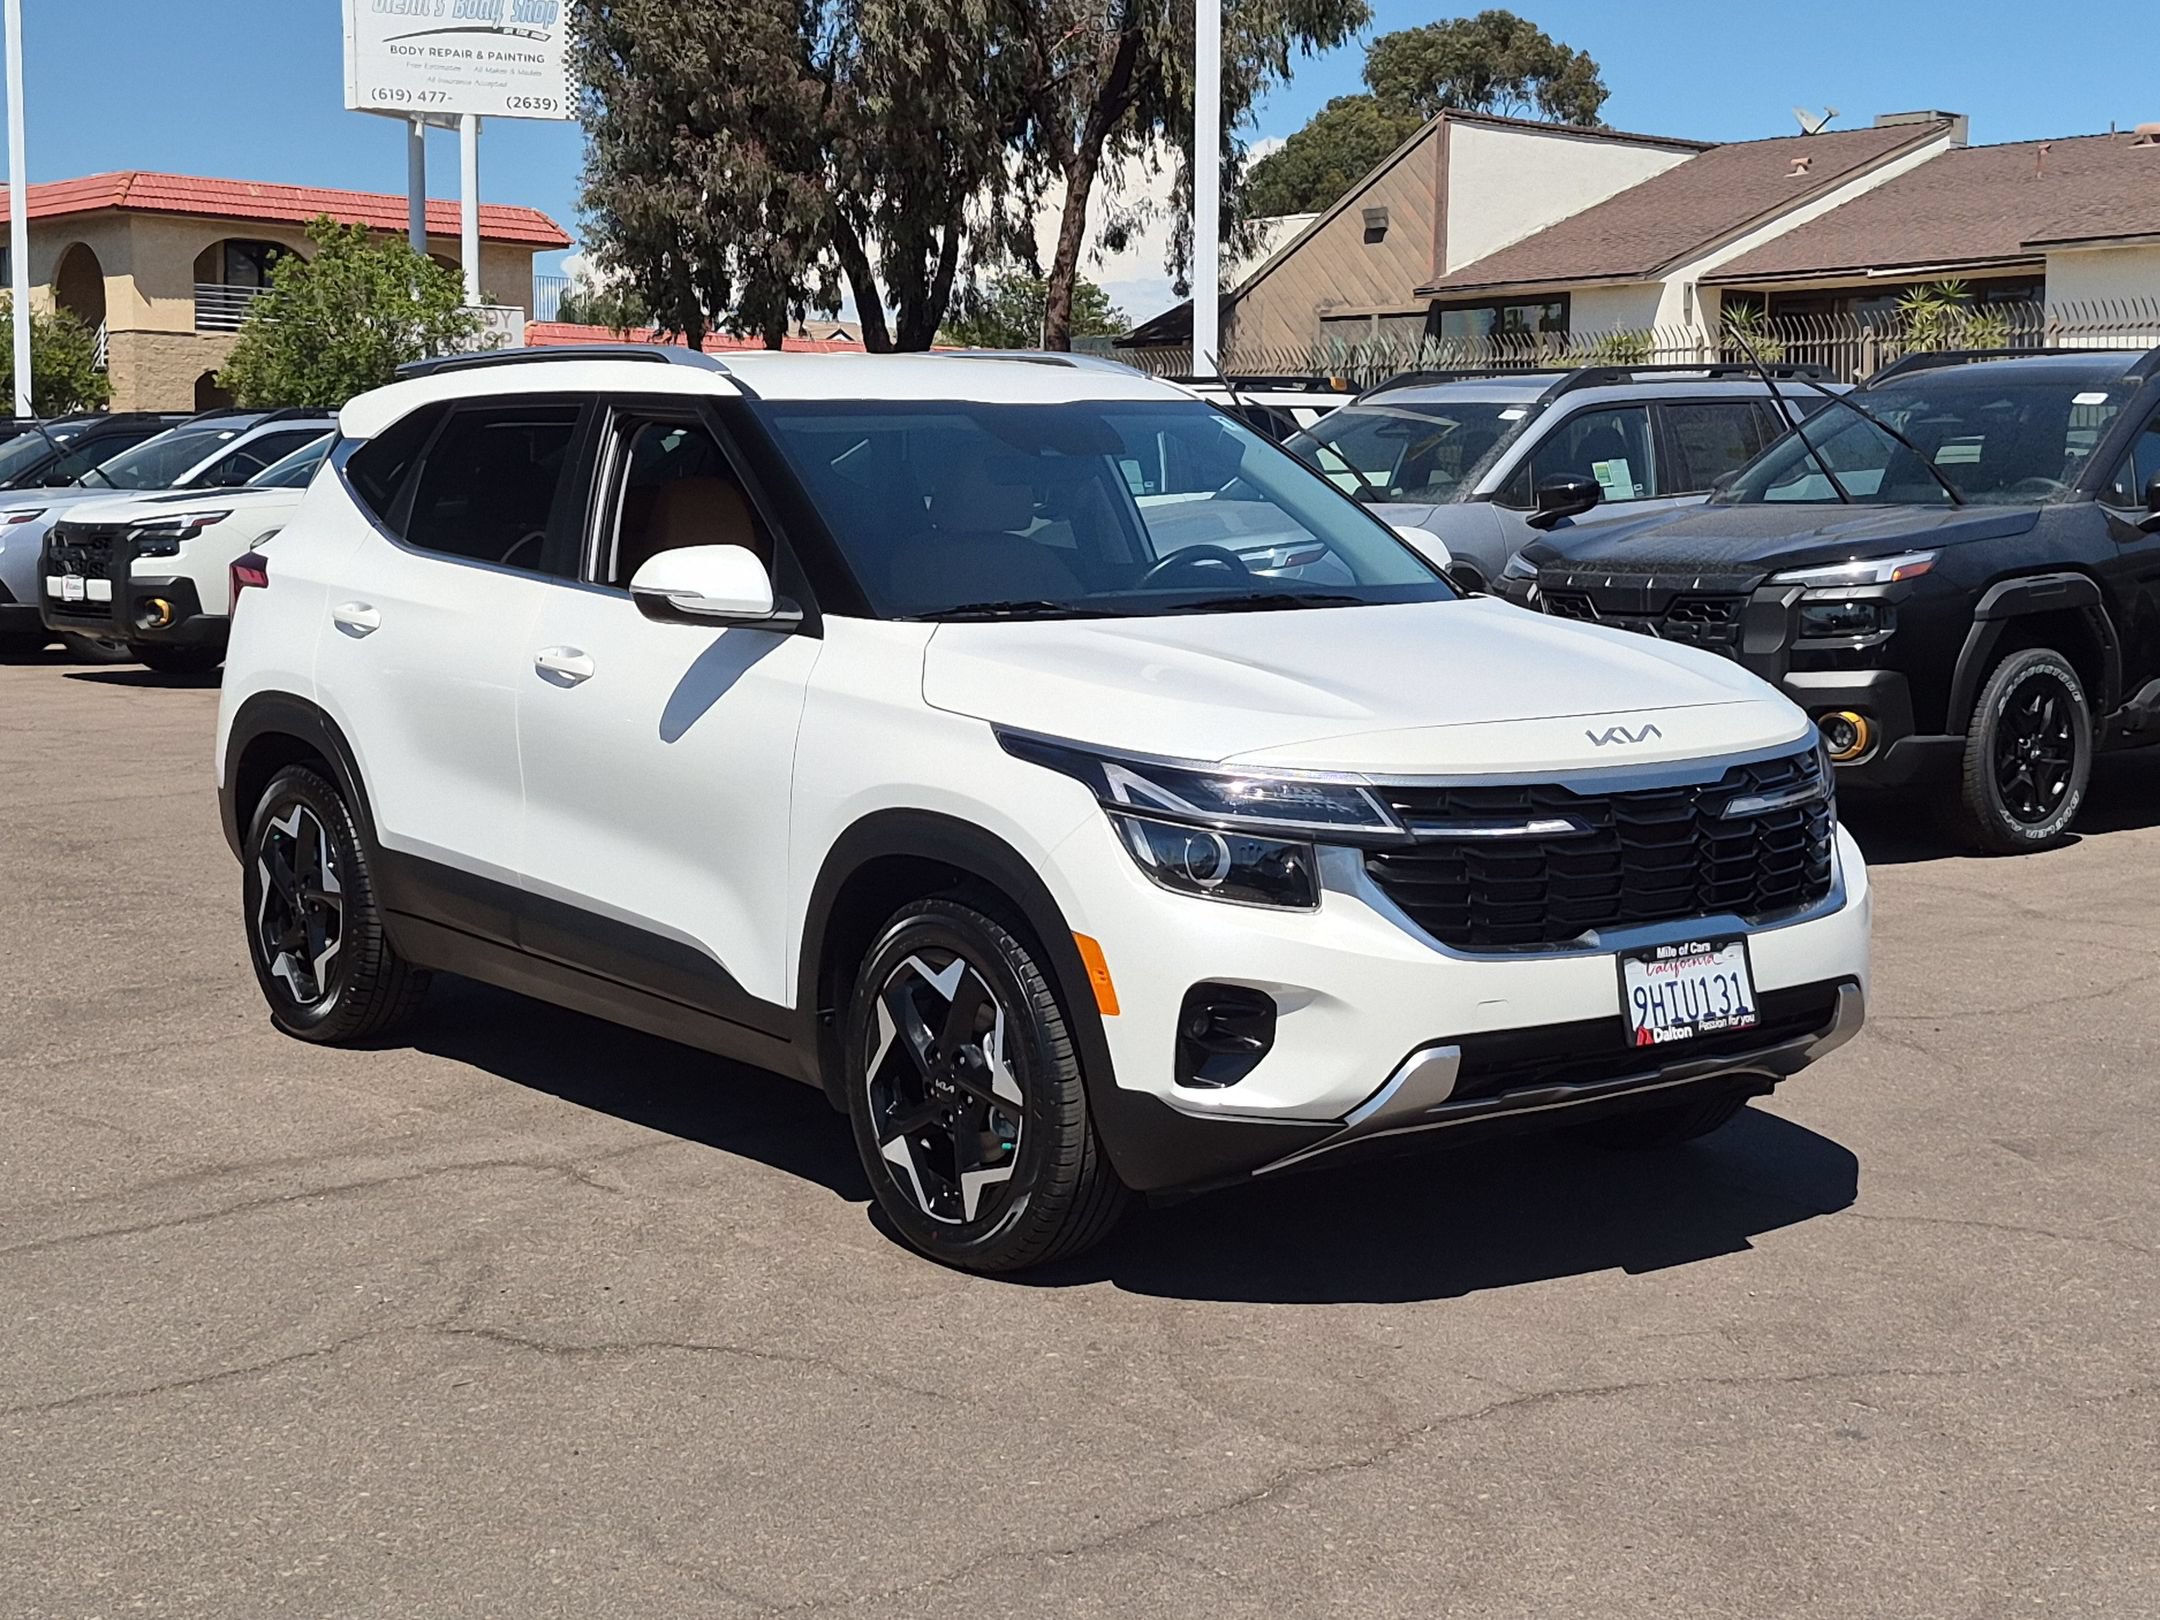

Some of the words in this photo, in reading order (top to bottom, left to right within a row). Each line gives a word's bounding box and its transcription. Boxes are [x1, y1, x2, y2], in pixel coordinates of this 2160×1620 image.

[389, 45, 425, 57] BODY
[428, 47, 473, 60] REPAIR
[476, 50, 484, 60] &
[488, 51, 546, 64] PAINTING
[371, 87, 413, 104] (619)
[506, 96, 559, 113] (2639)
[1585, 724, 1663, 747] KIA
[1656, 945, 1677, 959] Mile
[1679, 943, 1690, 956] of
[1690, 941, 1712, 954] Cars
[1652, 1025, 1694, 1044] Dalton
[1728, 1015, 1741, 1027] for
[1740, 1013, 1756, 1027] you
